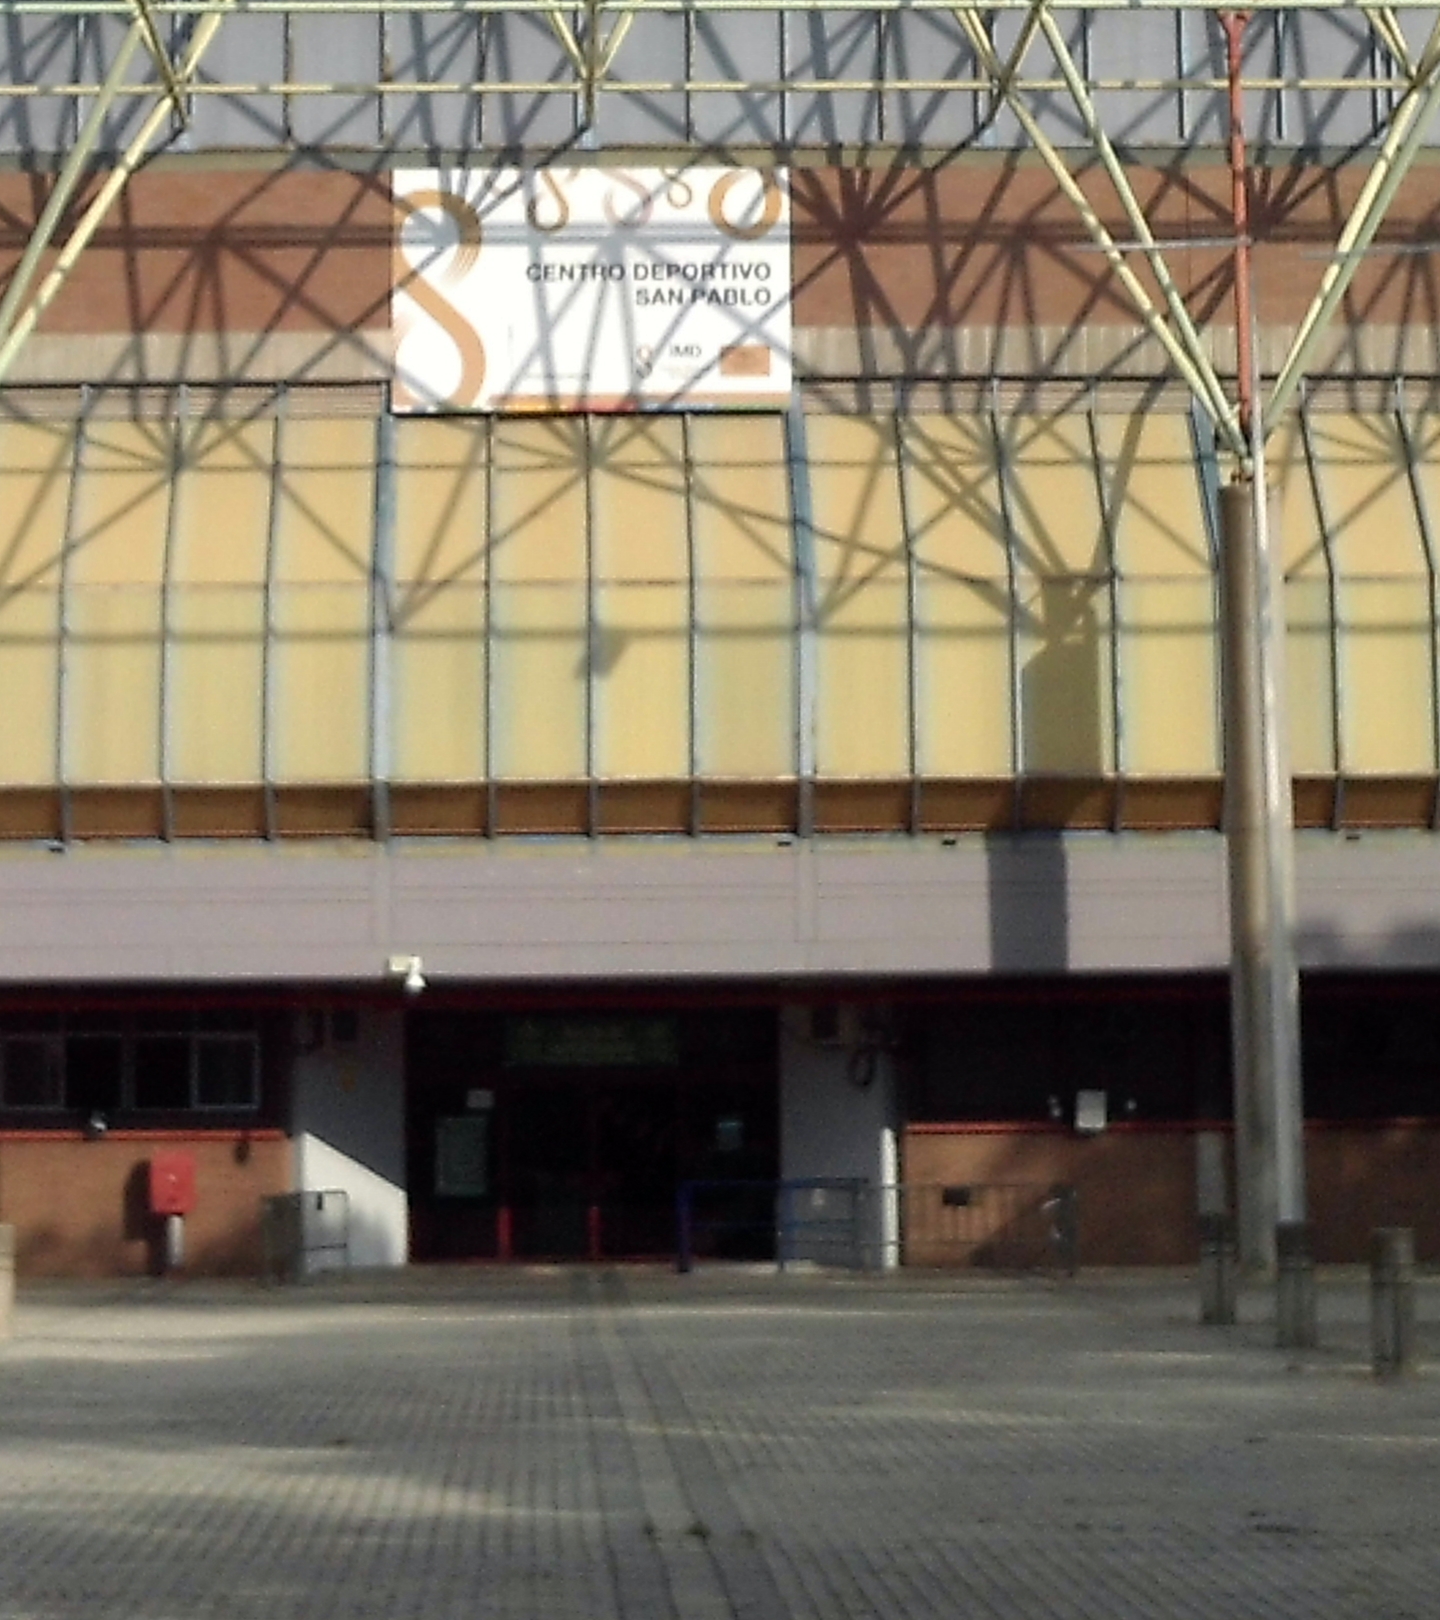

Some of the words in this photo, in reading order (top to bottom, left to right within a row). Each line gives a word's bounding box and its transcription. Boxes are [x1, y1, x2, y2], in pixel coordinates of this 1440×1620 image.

[526, 262, 625, 282] CENTRO
[633, 262, 771, 281] DEPORTIVO
[635, 287, 684, 306] SAN
[691, 287, 771, 306] PABLO
